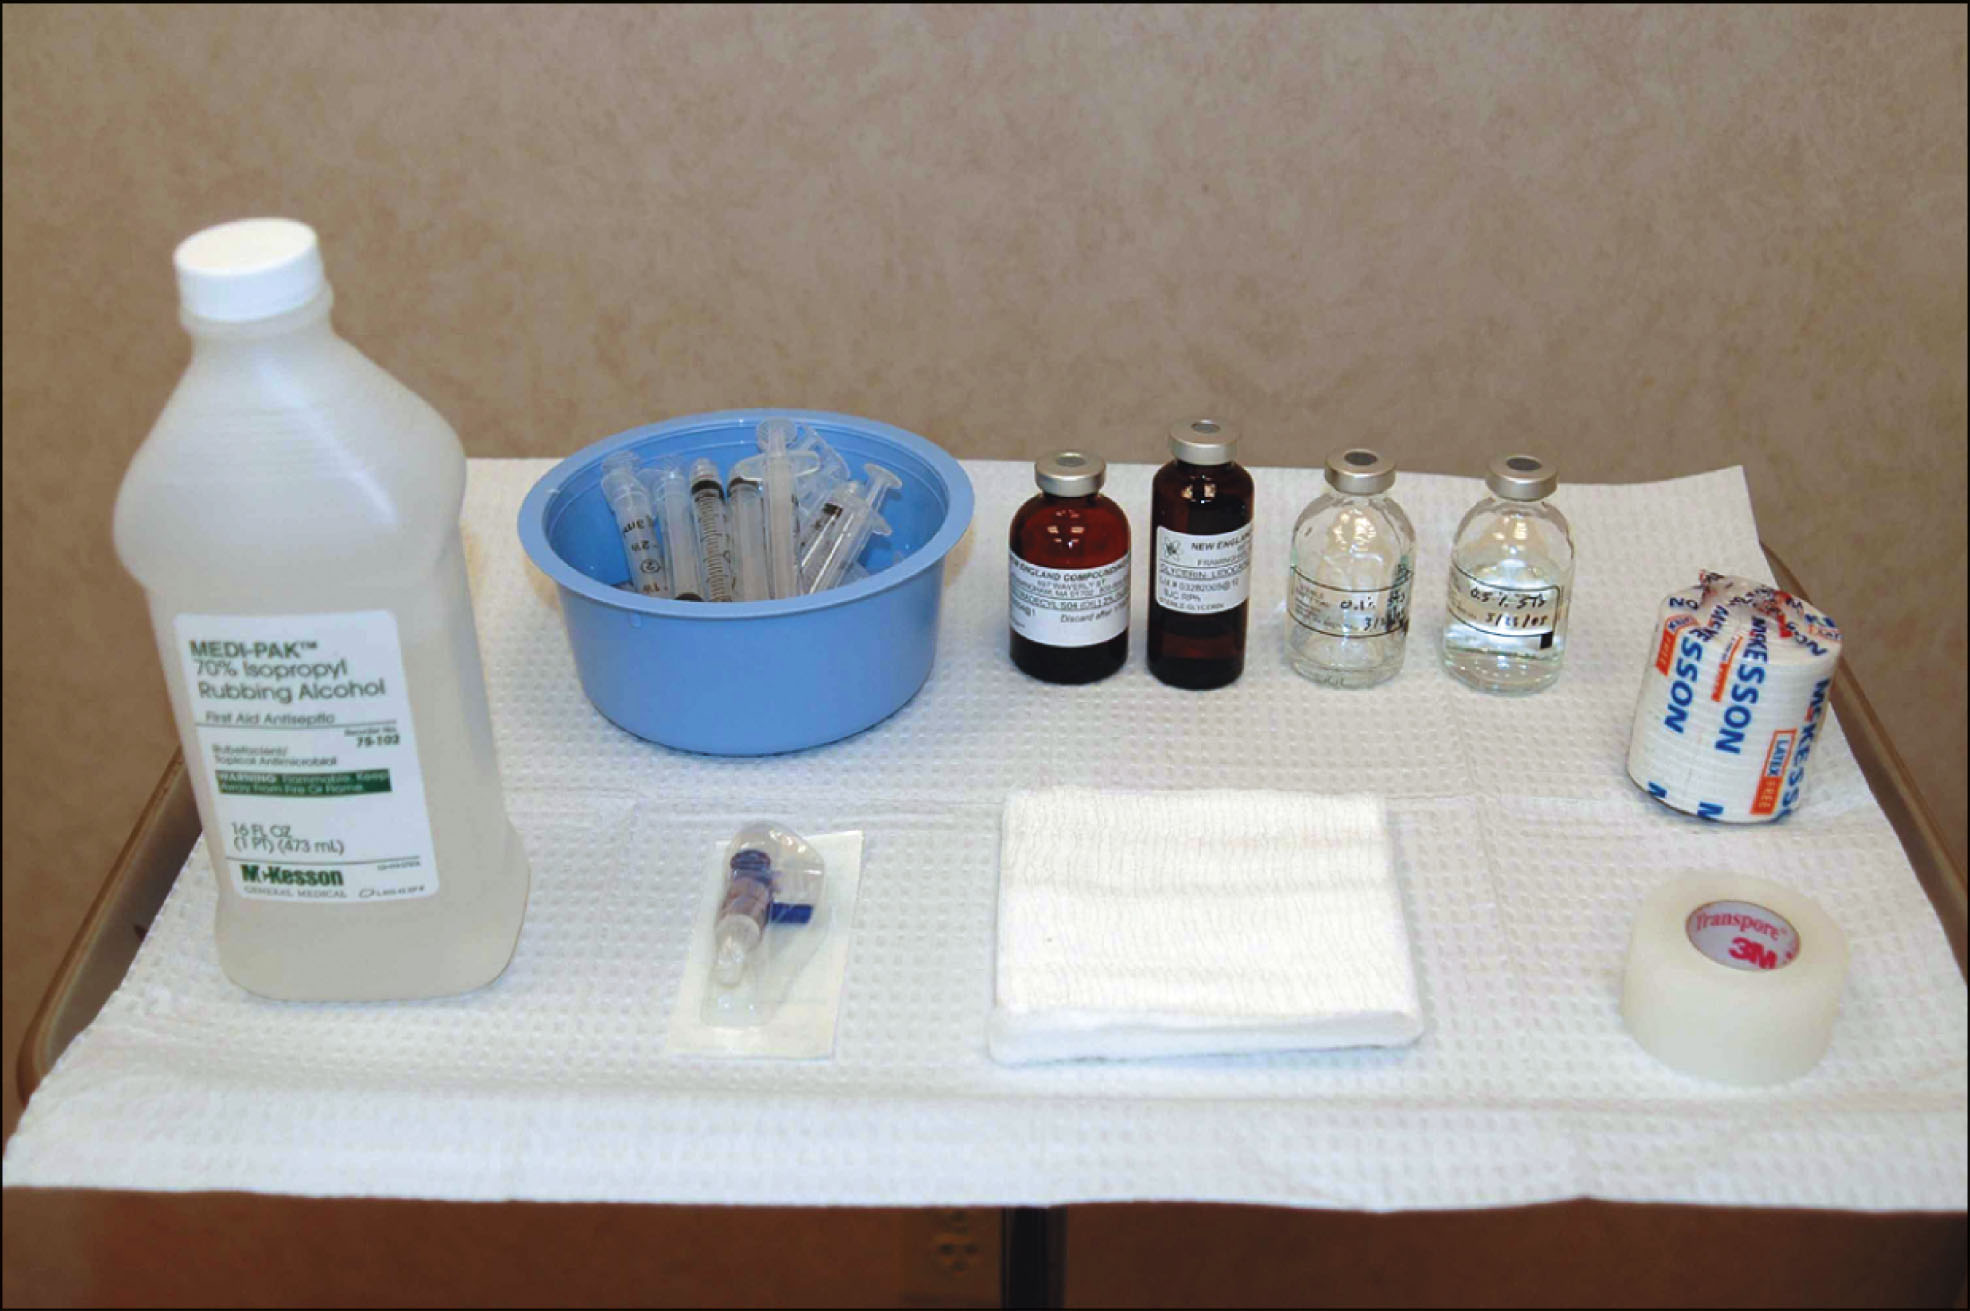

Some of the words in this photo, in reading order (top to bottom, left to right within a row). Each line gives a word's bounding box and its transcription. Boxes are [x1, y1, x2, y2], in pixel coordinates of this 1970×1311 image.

[1191, 542, 1215, 551] NEW
[194, 658, 238, 678] 70%
[242, 657, 348, 681] Isopropyl
[198, 681, 293, 704] Rubbing
[299, 677, 386, 700] Alcohol
[205, 711, 232, 723] First
[236, 711, 260, 724] Aid
[263, 711, 335, 726] Antiseptic
[215, 755, 257, 766] Topical
[260, 755, 337, 766] Antimicrobial
[231, 822, 249, 836] 16
[251, 824, 267, 838] FL
[270, 824, 291, 838] OZ
[233, 836, 248, 852] (1
[277, 837, 311, 856] (473
[243, 886, 293, 897] GENERAL
[297, 887, 347, 898] MEDICAL
[1728, 936, 1779, 970] 3M
